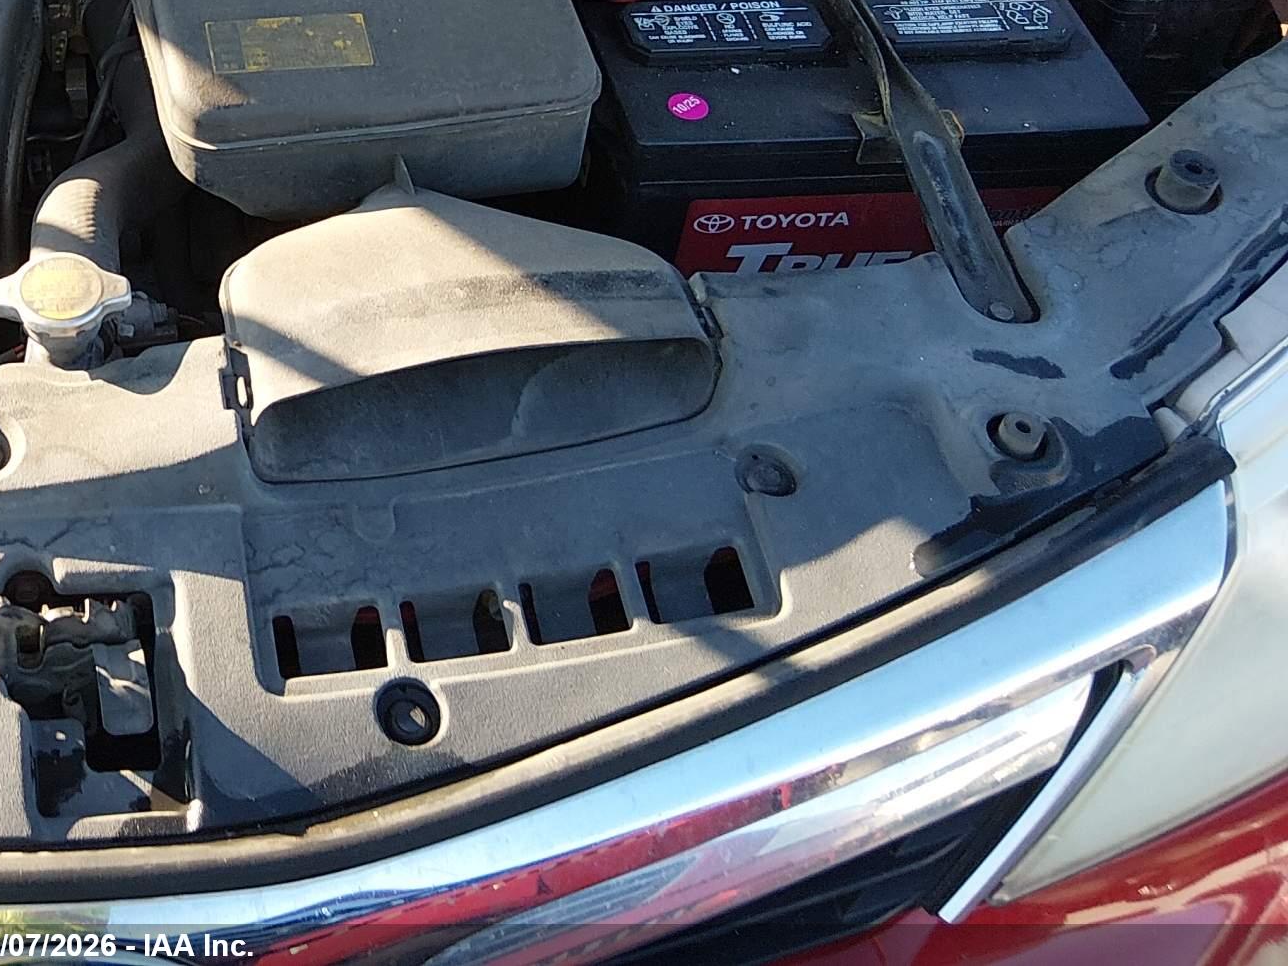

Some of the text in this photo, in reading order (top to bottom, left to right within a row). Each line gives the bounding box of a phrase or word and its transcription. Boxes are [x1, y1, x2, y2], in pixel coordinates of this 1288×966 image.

[663, 3, 718, 13] DANGER
[729, 0, 781, 11] POISON
[672, 95, 701, 114] 10/25
[740, 211, 850, 231] TOYOTA
